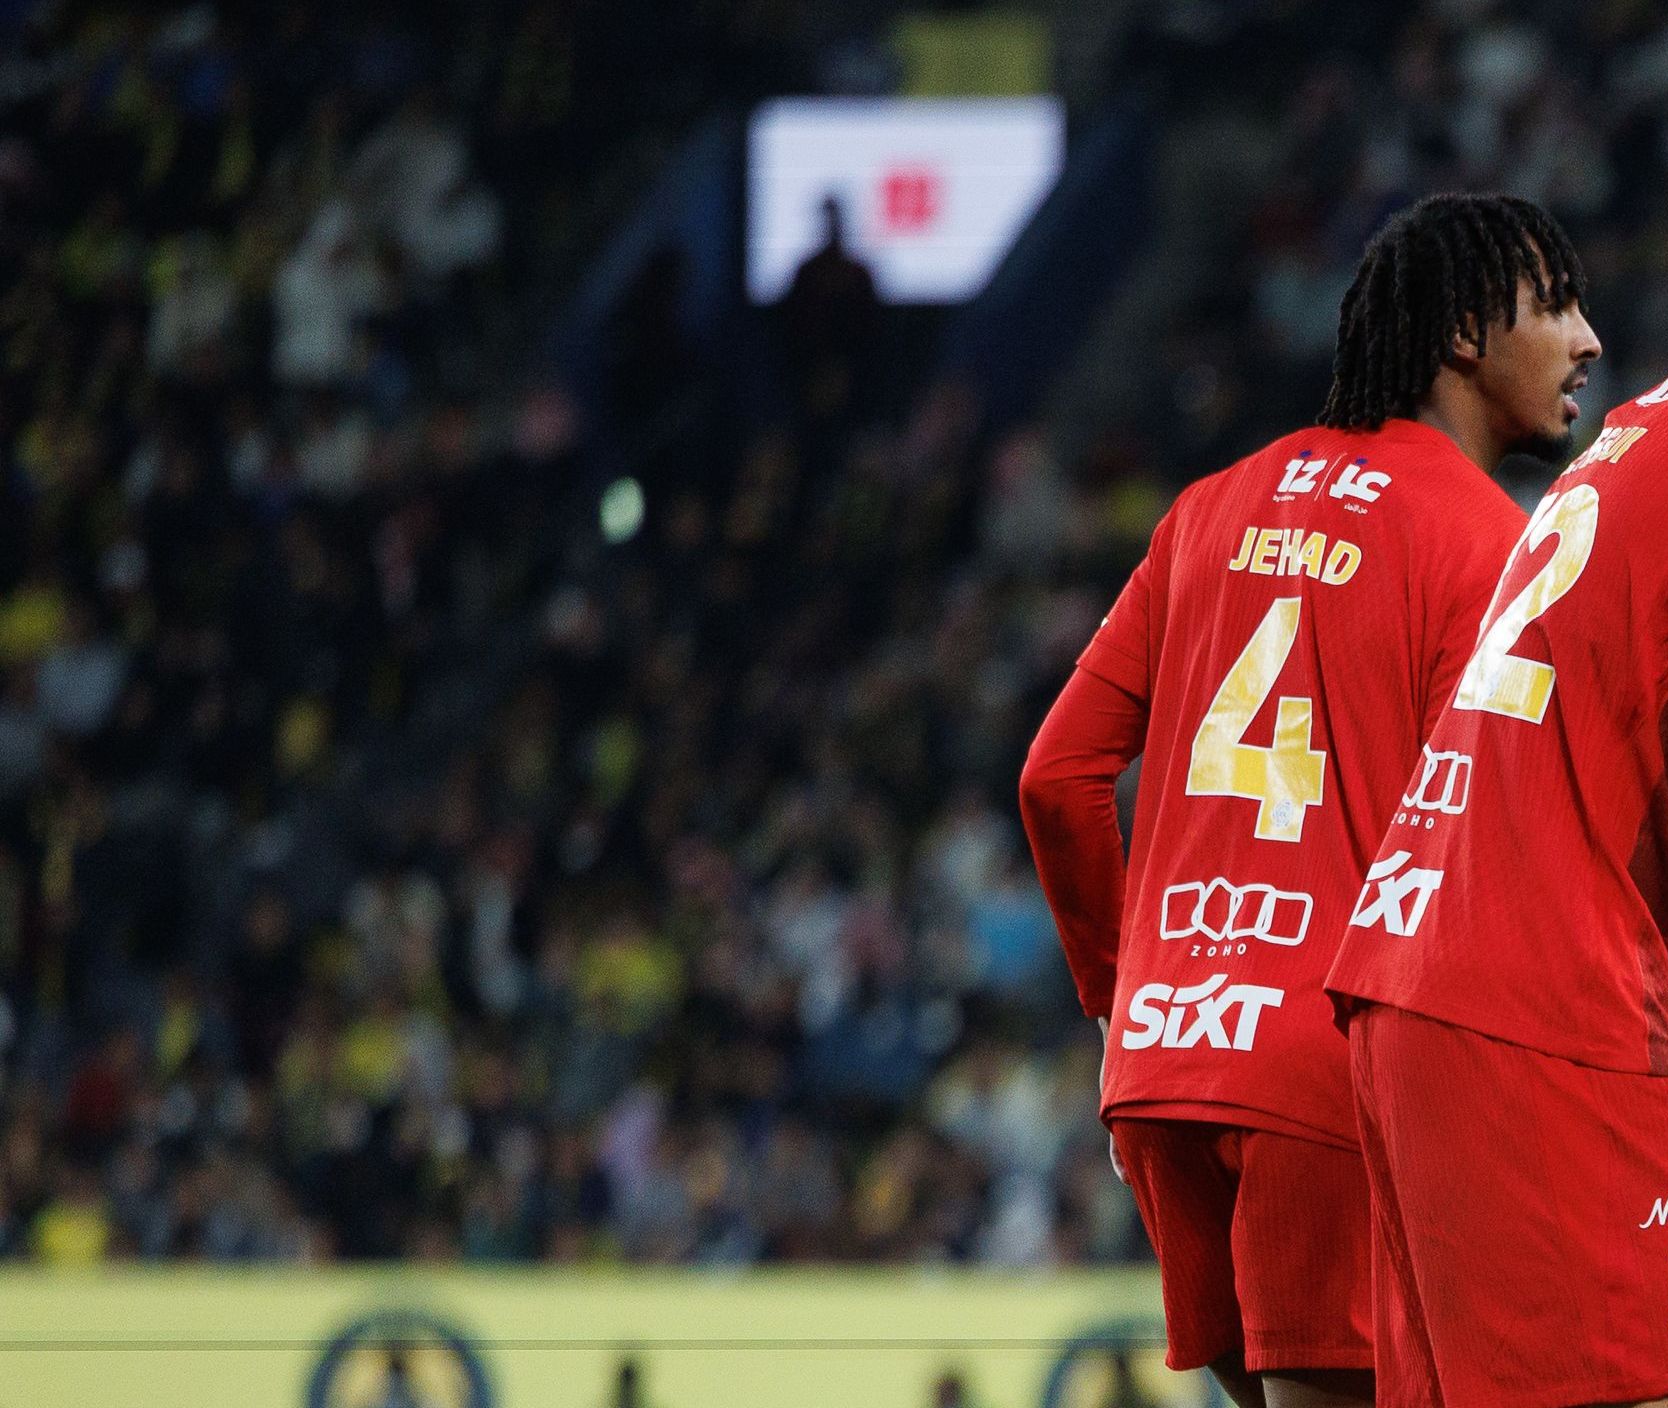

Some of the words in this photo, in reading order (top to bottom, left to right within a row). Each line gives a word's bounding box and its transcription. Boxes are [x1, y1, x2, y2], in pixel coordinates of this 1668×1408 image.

[1228, 526, 1363, 586] JEHAD
[1185, 596, 1327, 843] 4
[1349, 850, 1445, 938] IXT
[1190, 943, 1247, 958] ZOHO
